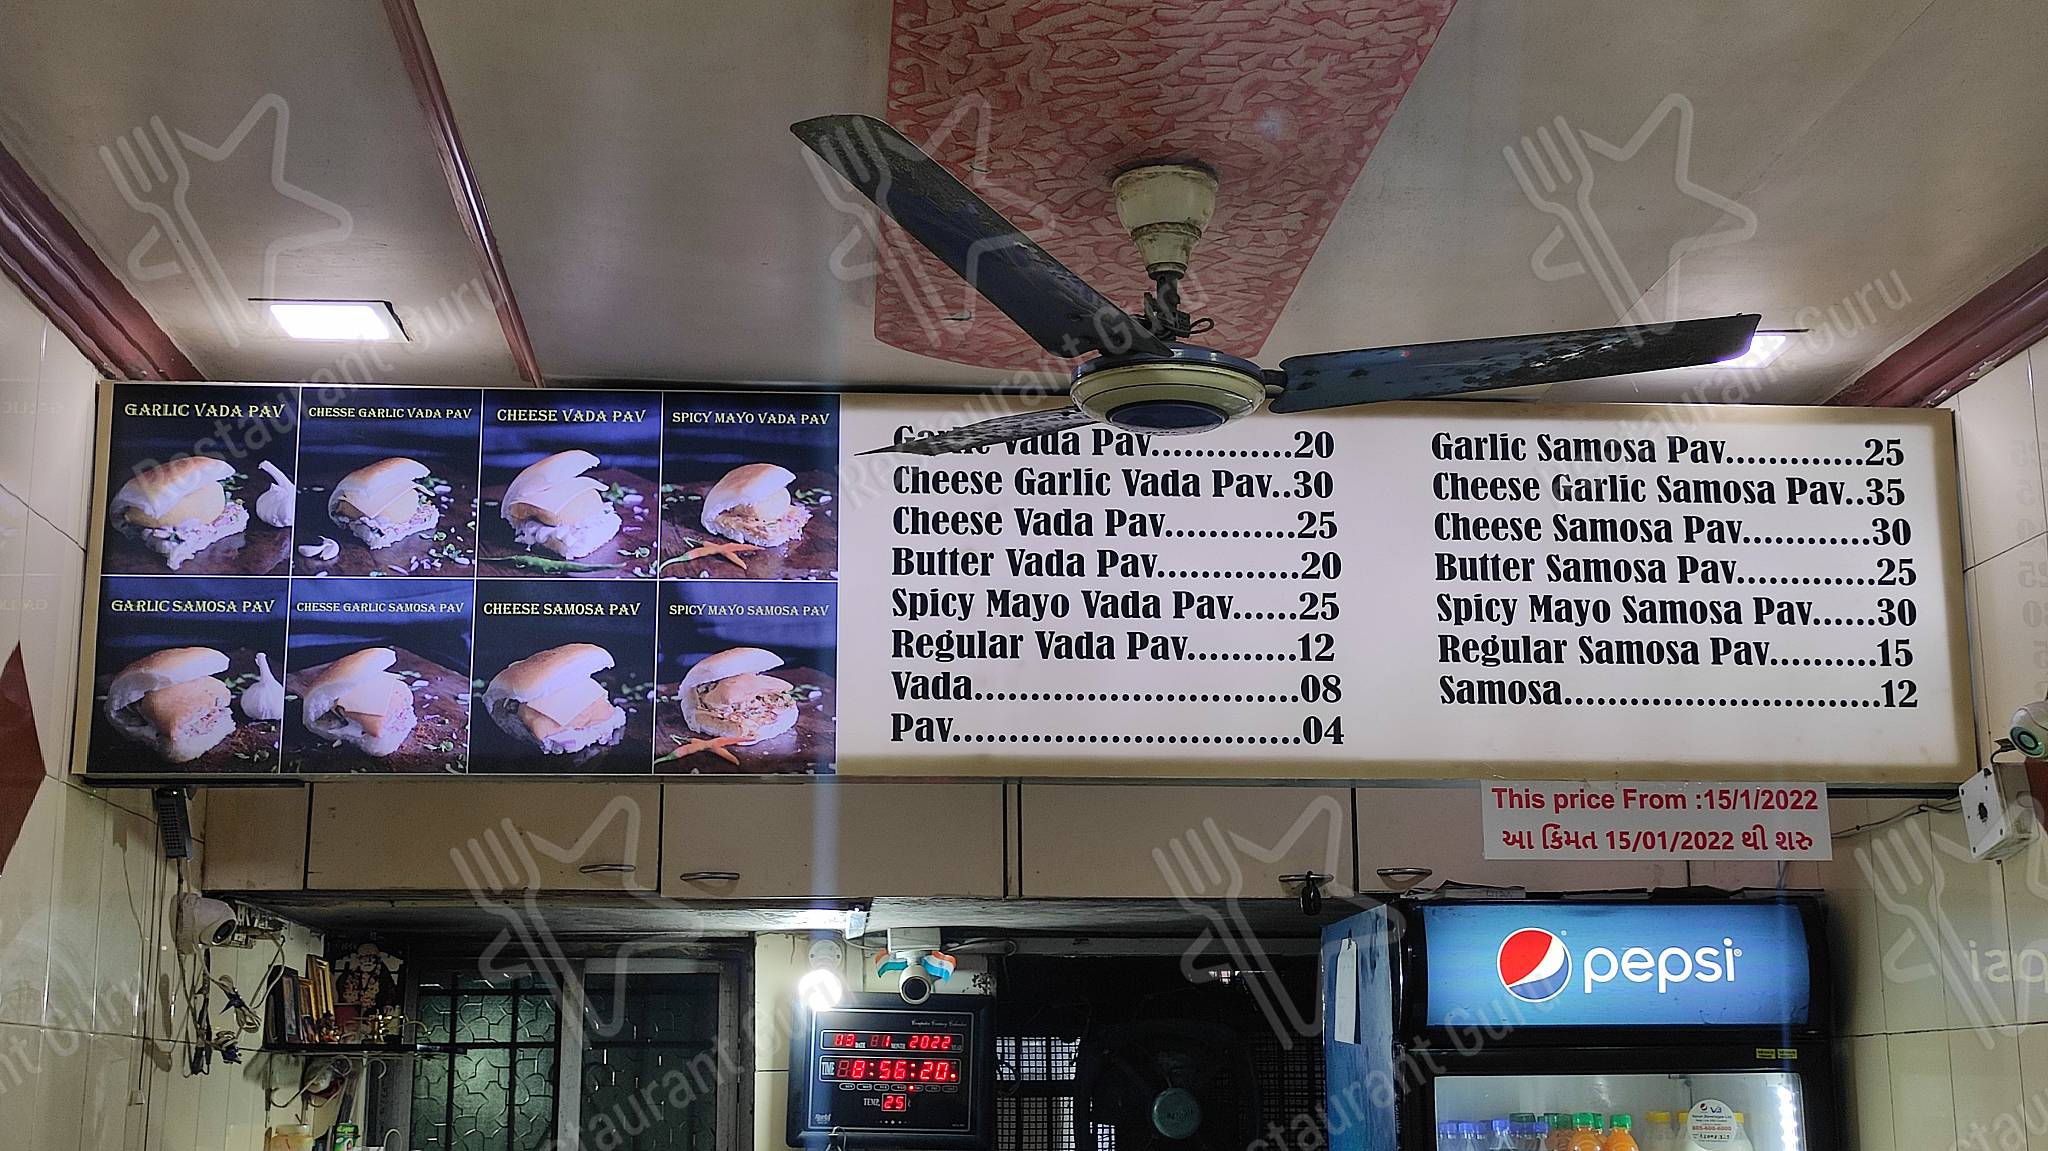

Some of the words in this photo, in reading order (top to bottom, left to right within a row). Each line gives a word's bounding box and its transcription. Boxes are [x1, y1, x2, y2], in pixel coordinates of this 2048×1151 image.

[125, 404, 189, 416] GARLIC
[195, 403, 243, 417] VADA
[249, 404, 285, 417] PAV
[309, 408, 355, 417] CHESSE
[359, 409, 404, 418] GARLIC
[407, 408, 441, 418] VADA
[447, 409, 472, 418] PAV
[497, 409, 557, 421] CHEESE
[562, 409, 607, 422] VADA
[613, 410, 646, 422] PAV
[673, 411, 712, 422] SPICY
[715, 412, 754, 423] MAYO
[758, 413, 796, 424] VADA
[802, 413, 829, 424] PAV
[112, 600, 169, 612] GARLIC
[173, 601, 237, 612] SAMOSA
[243, 600, 274, 612] PAV
[297, 603, 340, 611] CHESSE
[343, 603, 386, 612] GARLIC
[388, 603, 436, 612] SAMOSA
[440, 603, 464, 612] PAV
[484, 603, 539, 614] CHEESE
[544, 604, 604, 615] SAMOSA
[610, 603, 640, 615] PAV
[670, 604, 706, 615] SPICY
[709, 604, 744, 615] MAYO
[748, 606, 798, 615] SAMOSA
[804, 605, 829, 615] PAV
[1493, 787, 1545, 809] This
[1553, 790, 1614, 815] price
[1623, 787, 1687, 809] From
[1696, 789, 1817, 811] :15/1/2022
[1504, 831, 1532, 849] આ
[1608, 831, 1733, 852] 15/01/2022
[1741, 824, 1766, 850] થી
[1585, 939, 1734, 993] pepsi
[909, 1036, 951, 1049] 2022
[884, 1096, 904, 1109] 25
